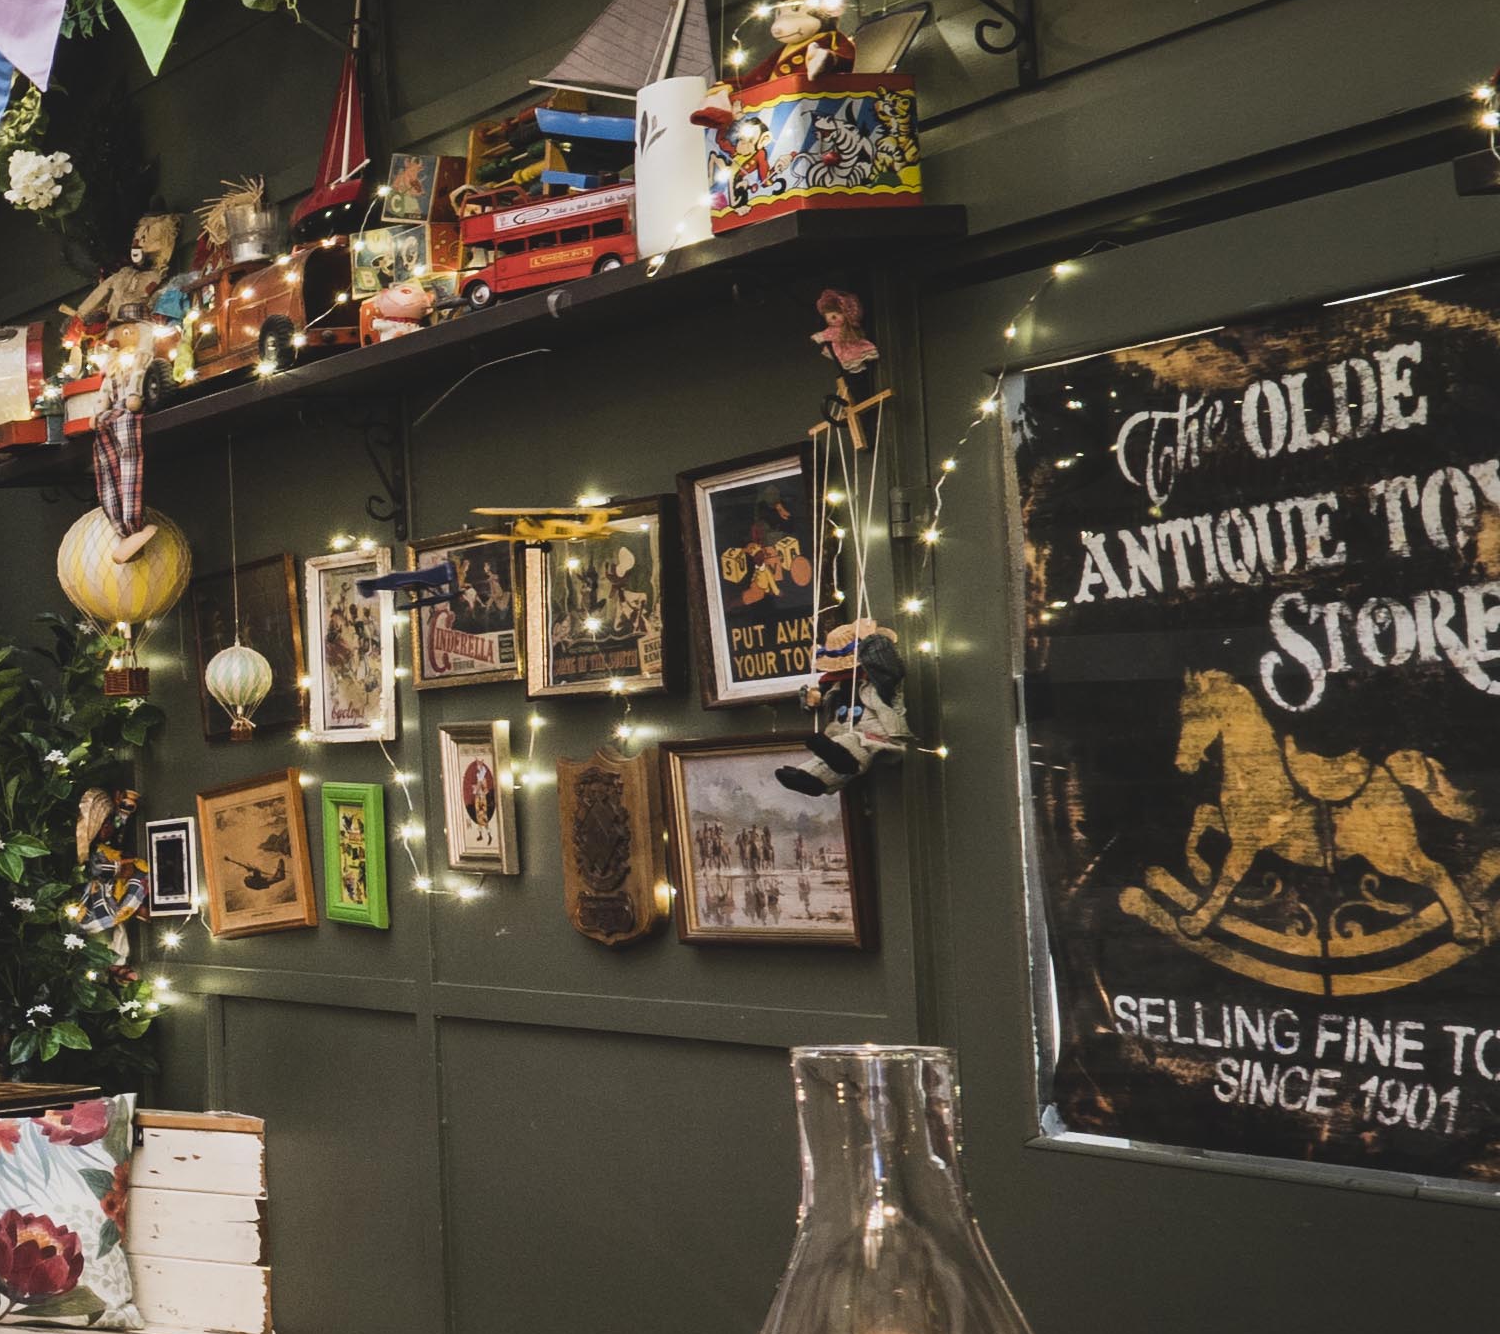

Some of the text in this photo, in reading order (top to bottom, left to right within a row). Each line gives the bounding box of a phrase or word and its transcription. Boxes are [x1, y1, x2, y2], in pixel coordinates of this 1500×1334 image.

[1116, 340, 1428, 505] The OLDE
[1073, 490, 1347, 604] ANTIQUE
[428, 609, 495, 674] CINDERELLA
[731, 624, 765, 651] PUT
[734, 646, 813, 679] YOUR TOY
[1259, 581, 1500, 713] STORE
[1113, 994, 1300, 1055] SELLING
[1315, 1014, 1425, 1070] FINE
[1213, 1058, 1462, 1134] SINCE 1901
